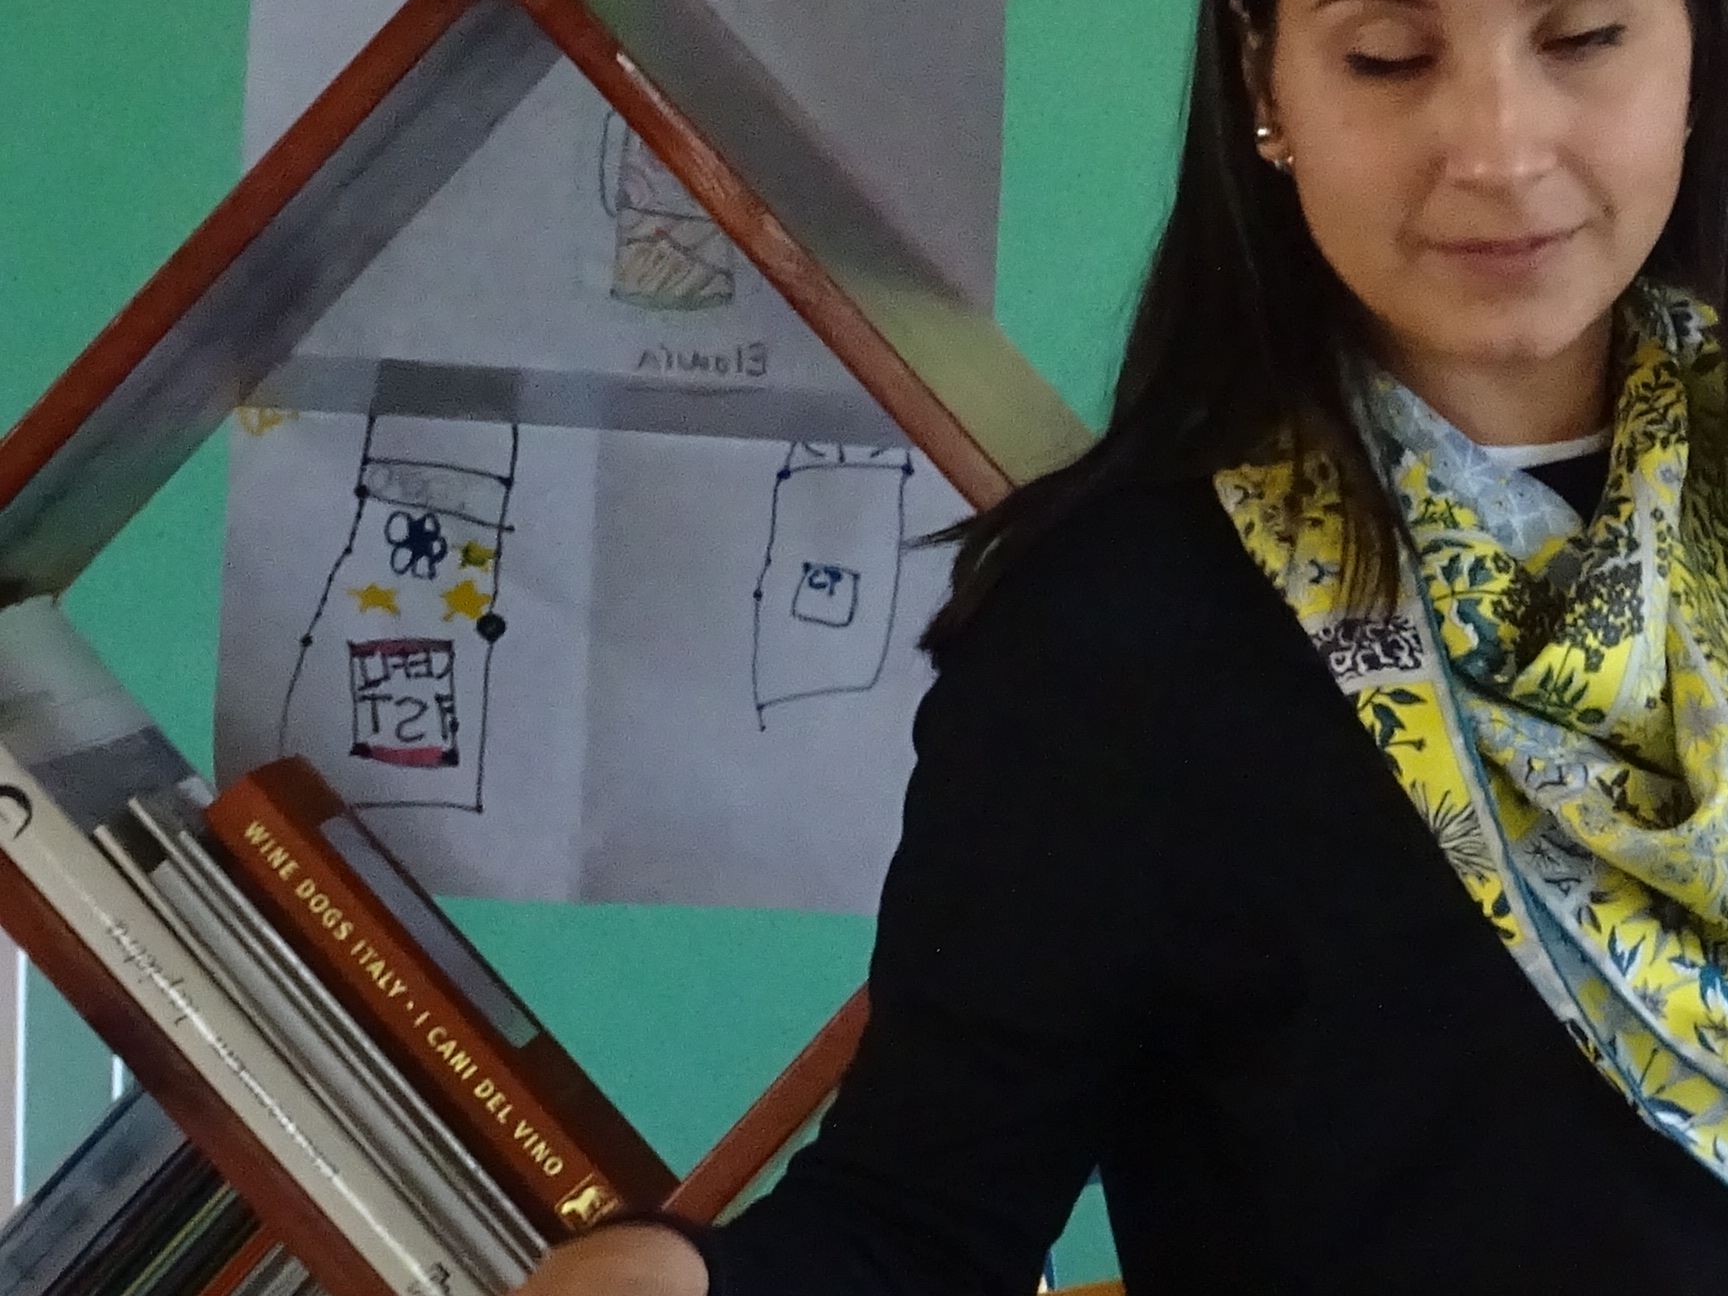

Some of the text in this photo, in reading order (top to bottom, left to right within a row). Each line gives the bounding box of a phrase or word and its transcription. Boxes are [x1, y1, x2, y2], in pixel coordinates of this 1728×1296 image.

[244, 820, 565, 1178] WINE DOGS ITALY I CANI DEL VINO
